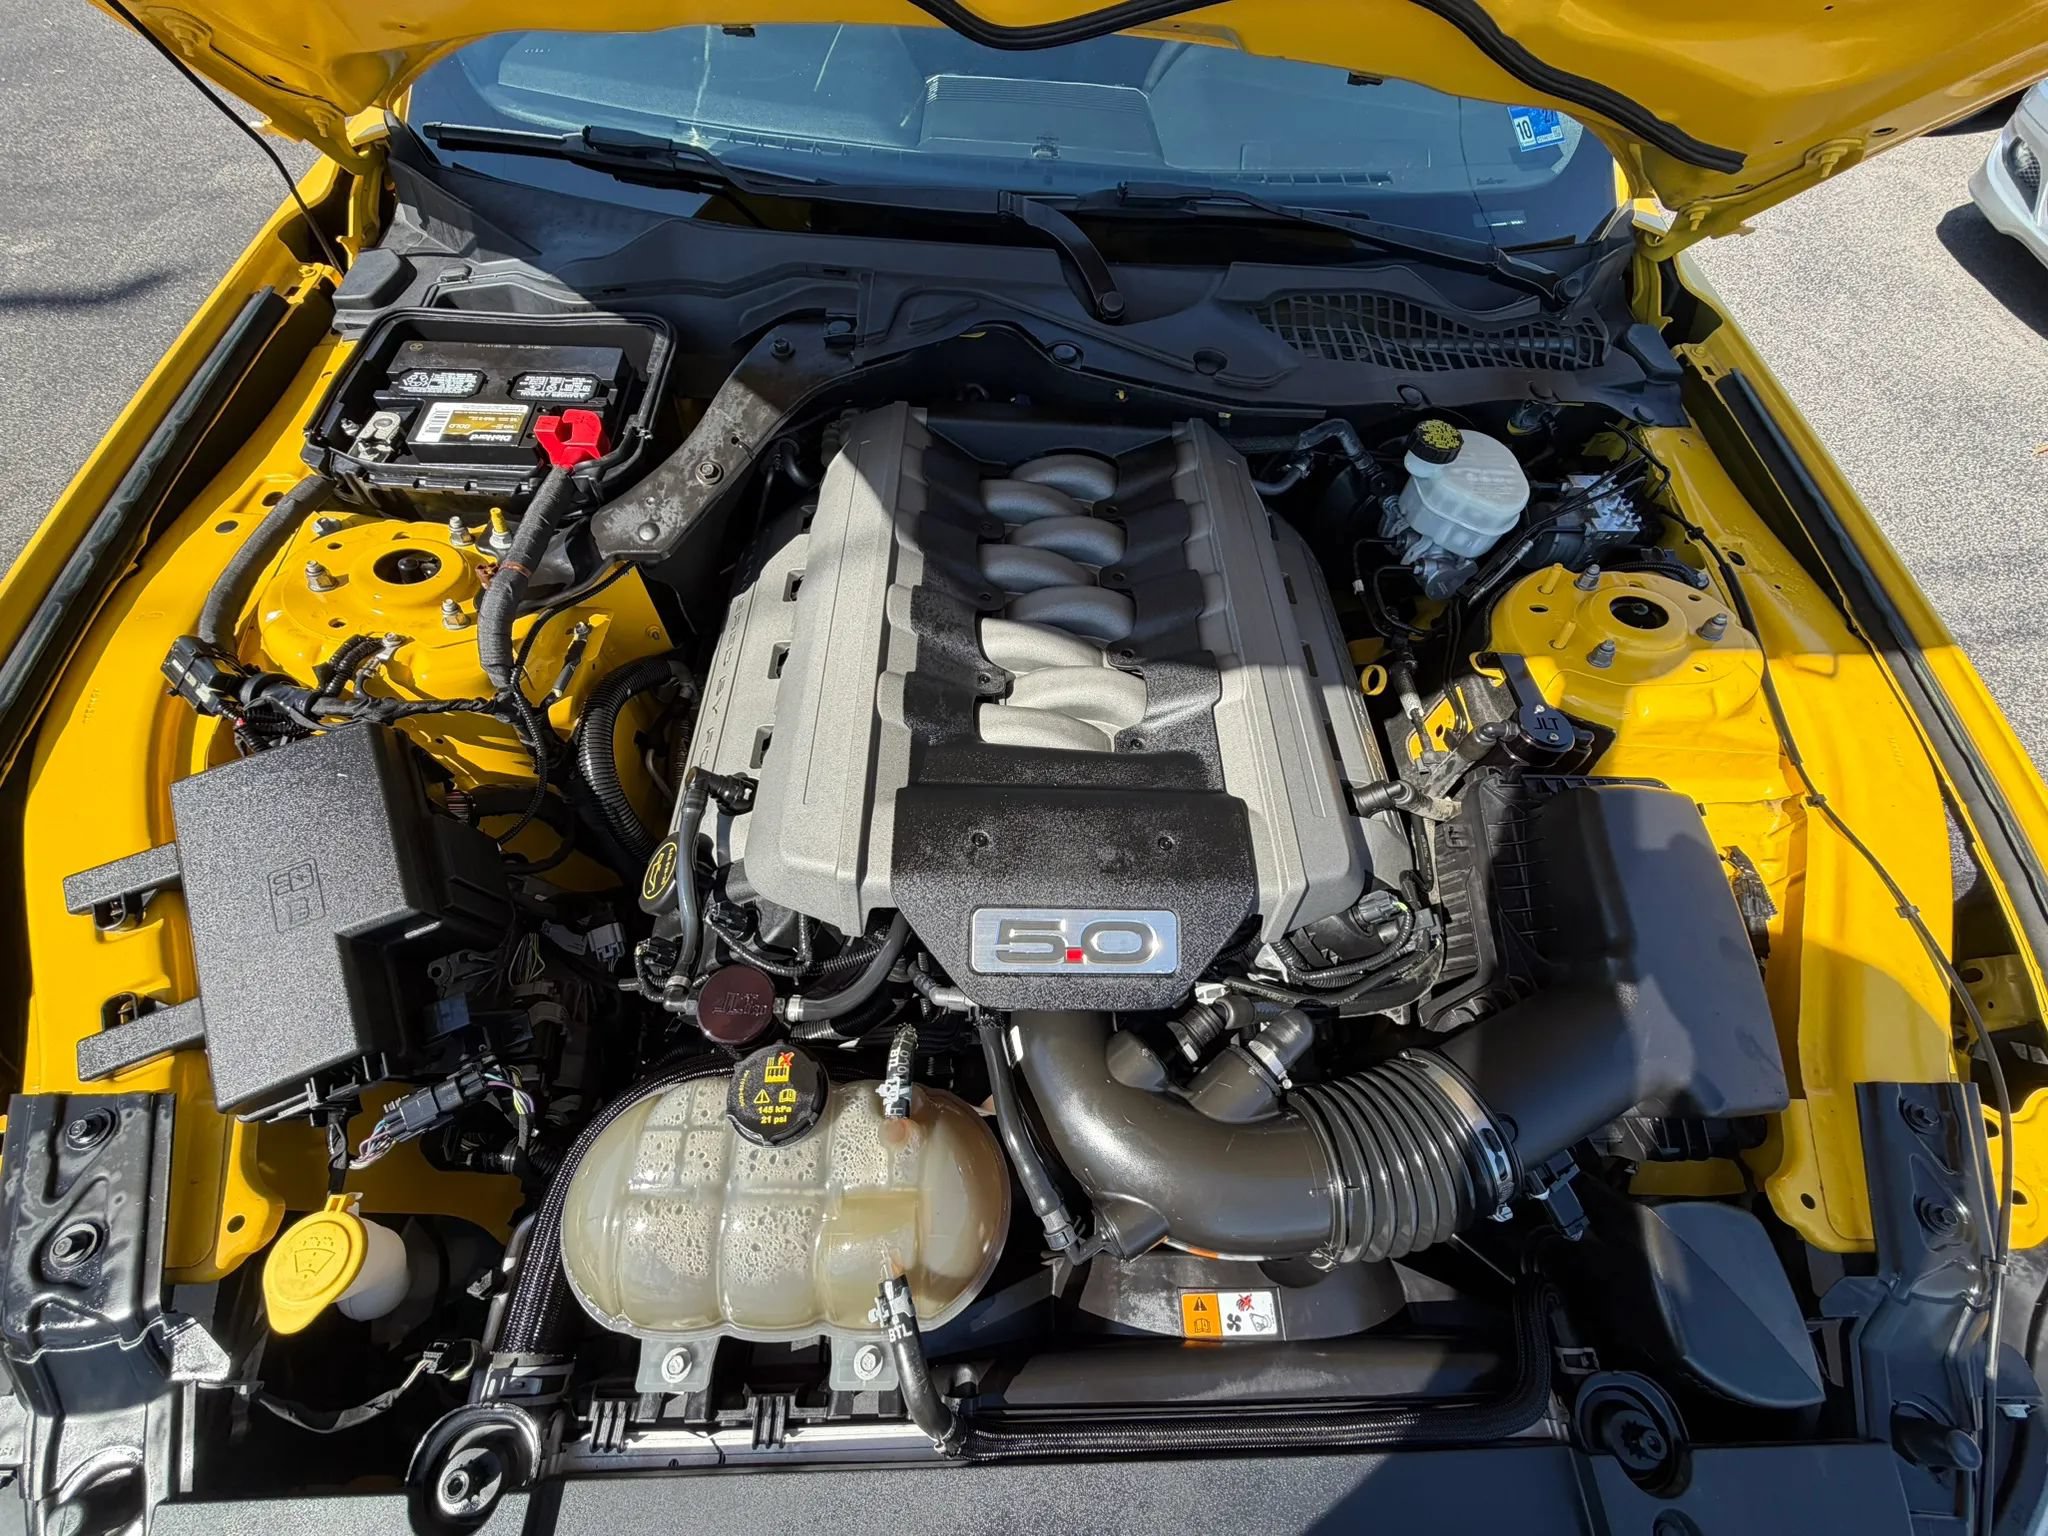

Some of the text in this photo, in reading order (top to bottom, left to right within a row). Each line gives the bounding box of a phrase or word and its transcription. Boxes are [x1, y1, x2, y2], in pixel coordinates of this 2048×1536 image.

[1516, 119, 1532, 140] 10
[469, 433, 512, 442] DieHard
[1534, 717, 1560, 731] JLT
[994, 917, 1160, 966] 5.0
[888, 1046, 901, 1071] BTL
[757, 1105, 792, 1114] 145 kPa
[761, 1115, 787, 1125] 21 psi
[888, 1323, 913, 1343] BTL
